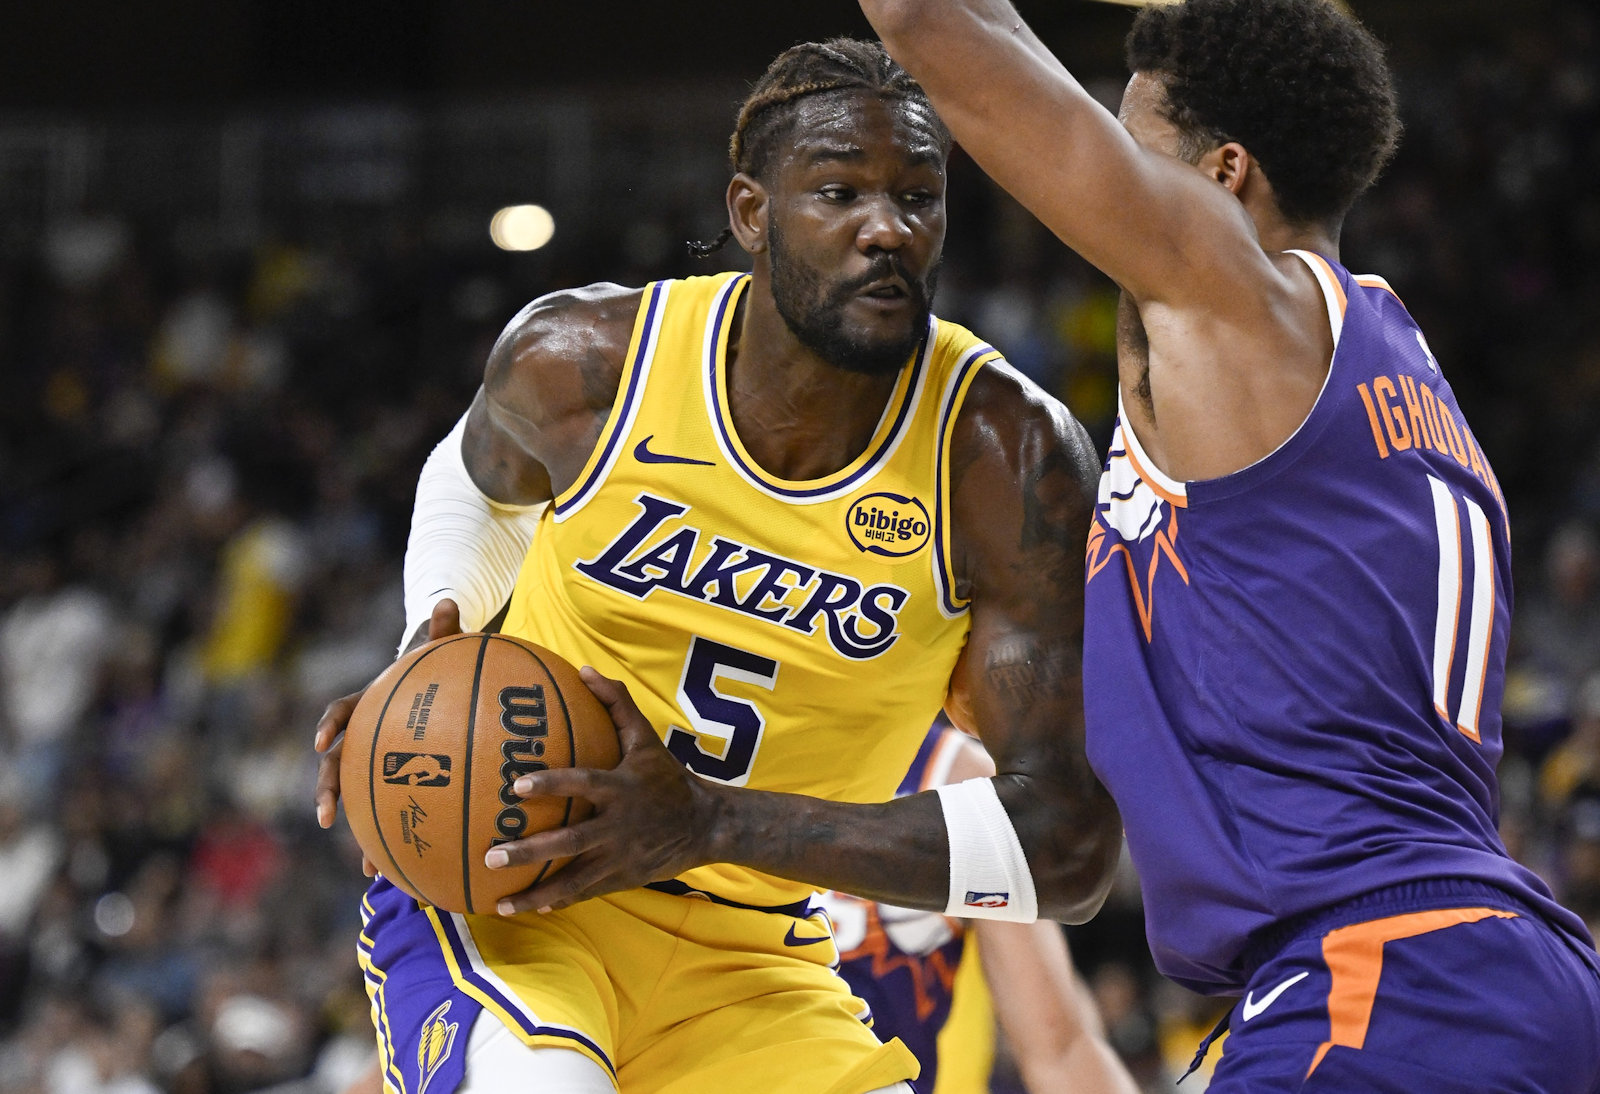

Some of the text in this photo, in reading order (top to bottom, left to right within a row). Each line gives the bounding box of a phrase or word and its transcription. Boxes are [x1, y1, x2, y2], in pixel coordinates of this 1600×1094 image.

[854, 506, 926, 540] bibigo
[1356, 374, 1511, 543] IGHODA
[572, 490, 912, 661] LAKERS
[865, 529, 894, 543] 비비고
[1427, 473, 1495, 744] 11
[386, 755, 397, 772] NBA
[413, 683, 439, 741] OFFICIAL GAME BALL
[492, 684, 549, 848] Wilso
[666, 635, 780, 787] 5
